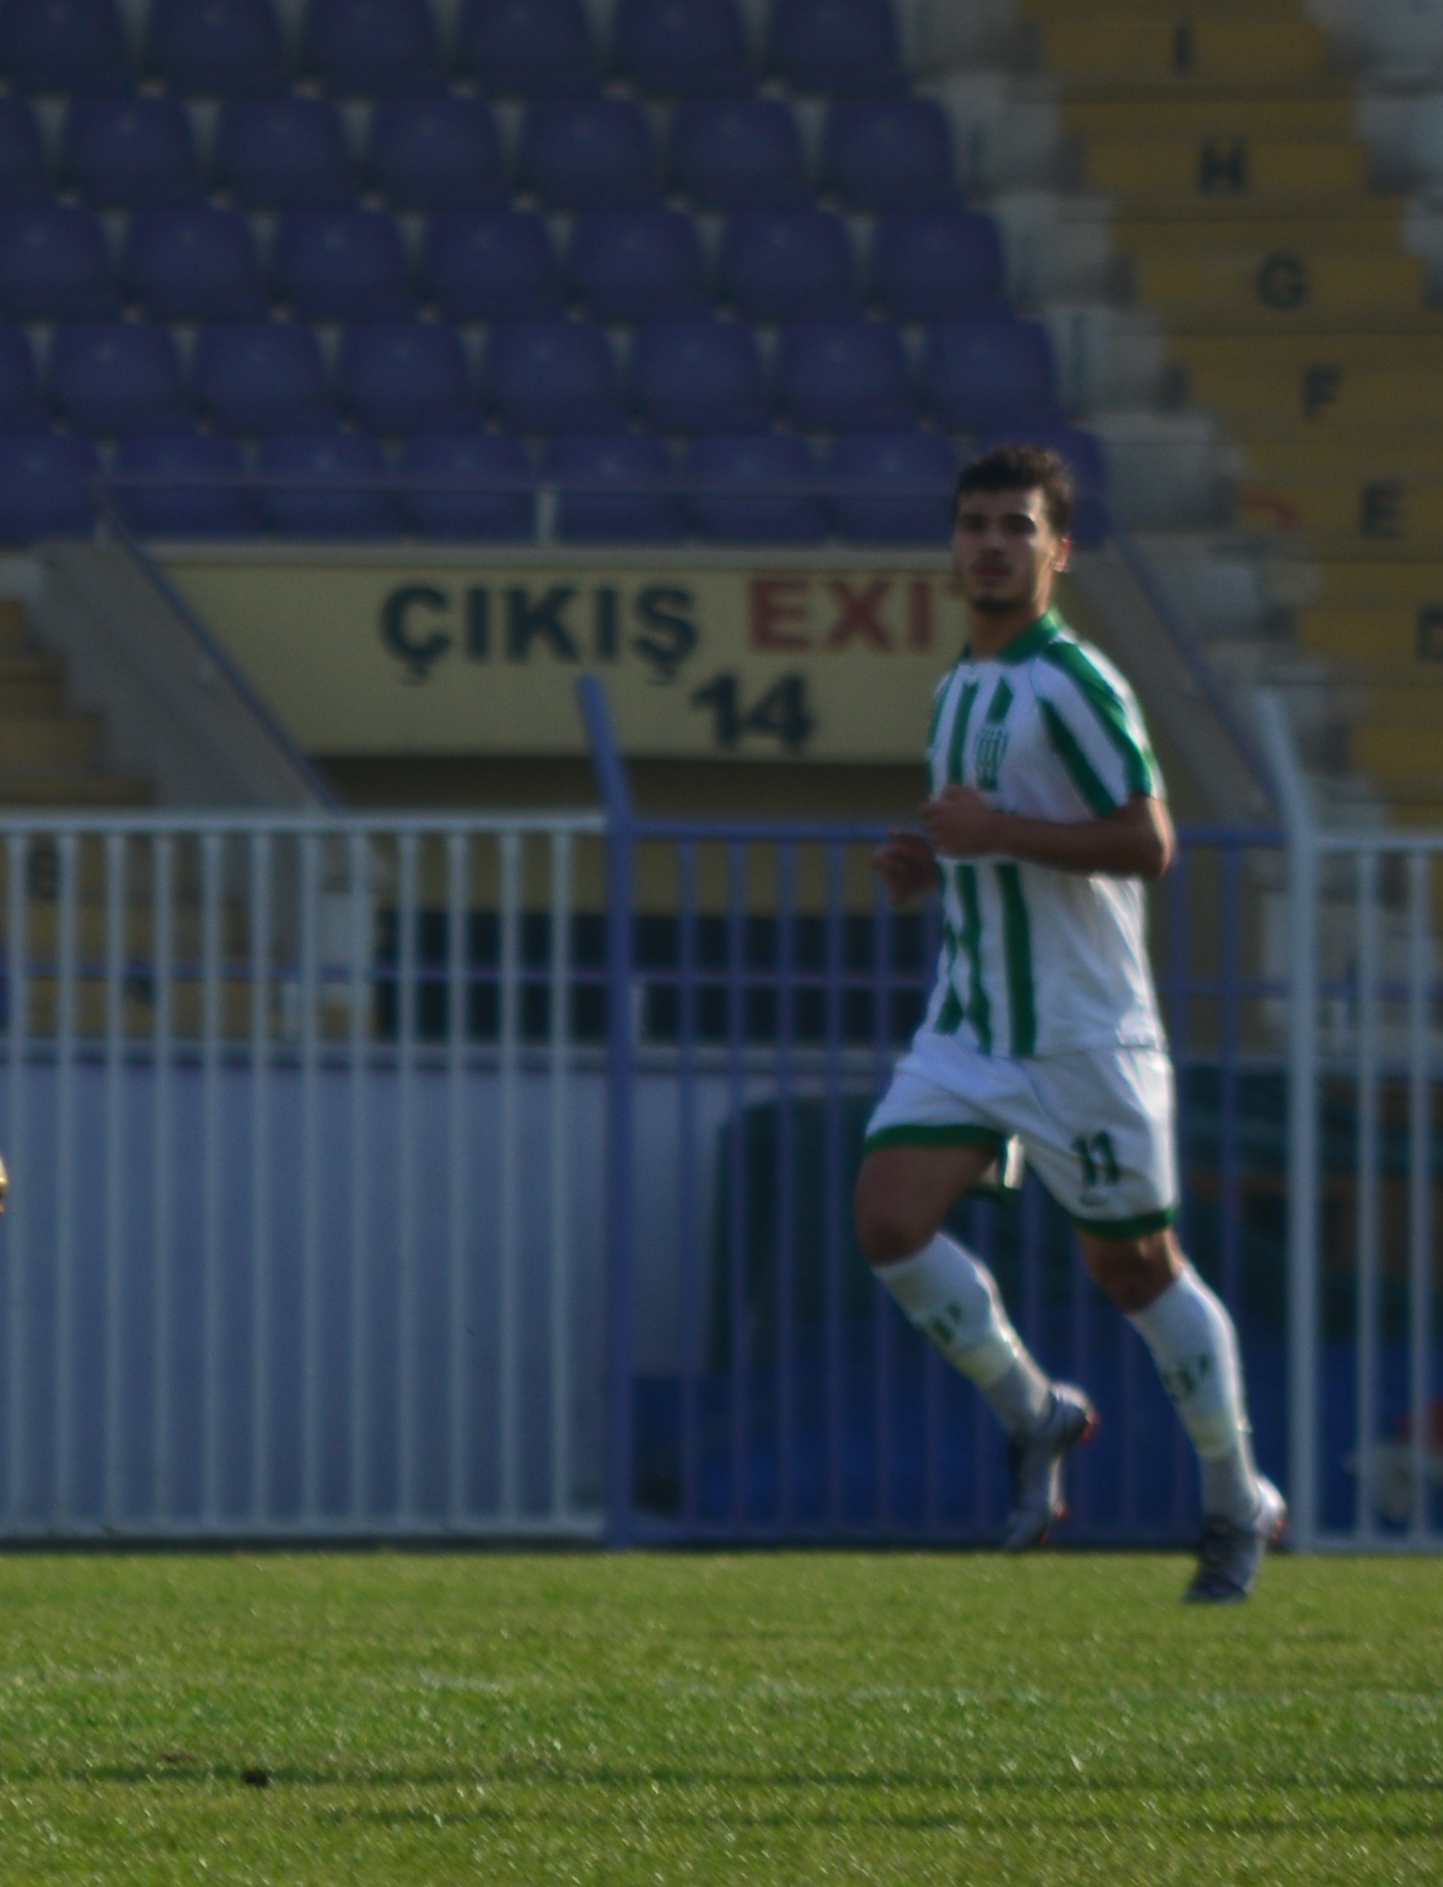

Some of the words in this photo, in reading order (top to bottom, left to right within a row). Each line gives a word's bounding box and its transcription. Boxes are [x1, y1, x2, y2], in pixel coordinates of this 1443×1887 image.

[1199, 145, 1247, 193] H
[1256, 253, 1307, 309] G
[1303, 365, 1341, 419] F
[1361, 483, 1399, 539] E
[381, 584, 699, 681] ÇIKIŞ
[749, 576, 944, 654] EXI
[692, 672, 815, 753] 14
[1071, 1130, 1122, 1188] 11
